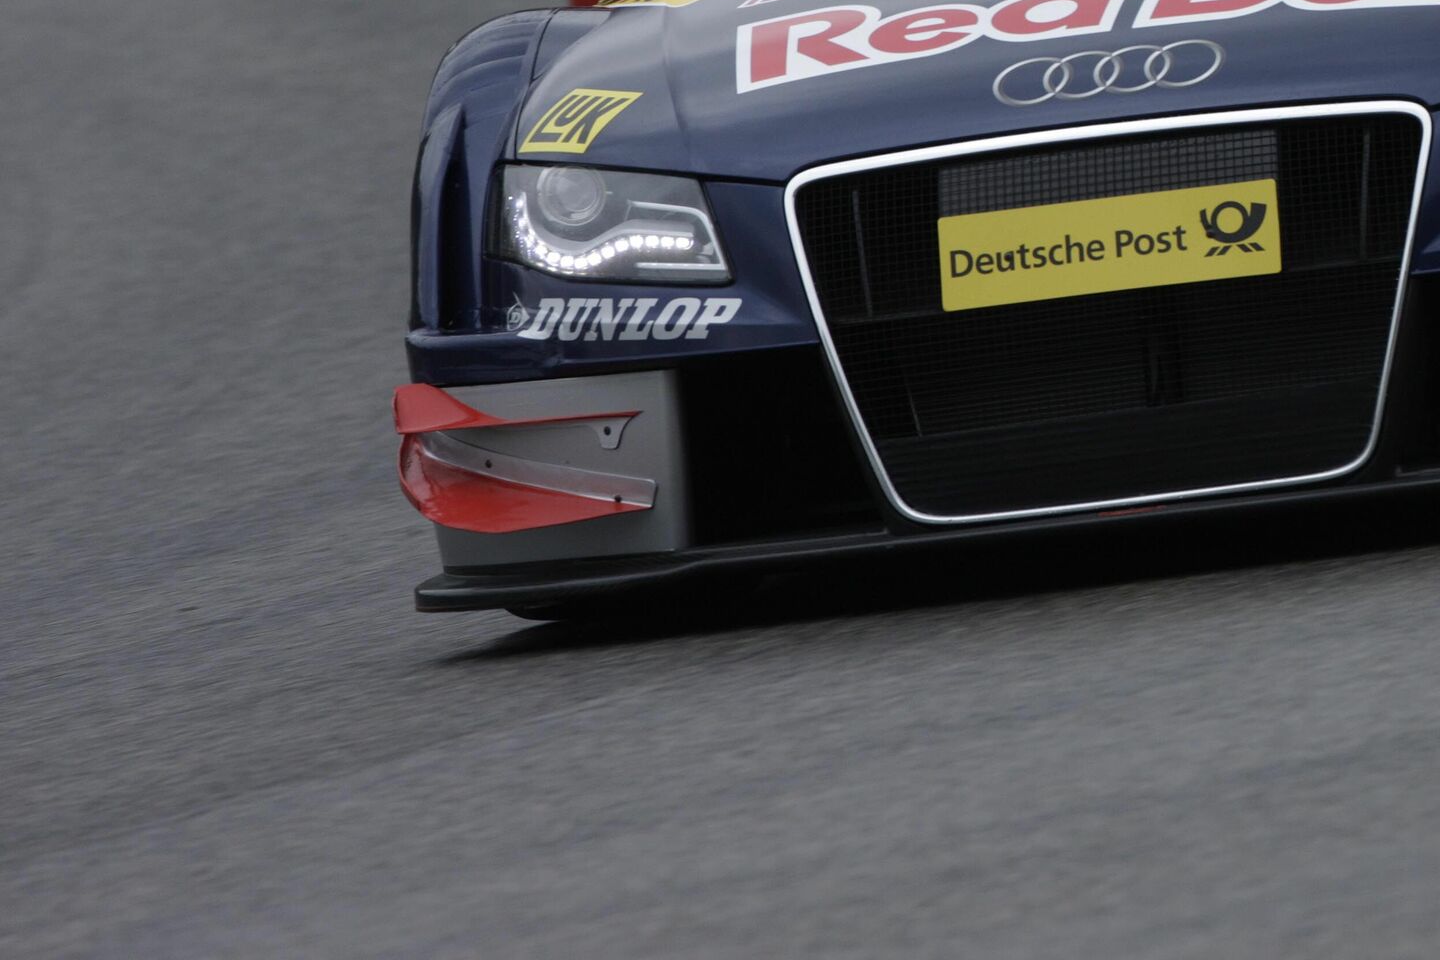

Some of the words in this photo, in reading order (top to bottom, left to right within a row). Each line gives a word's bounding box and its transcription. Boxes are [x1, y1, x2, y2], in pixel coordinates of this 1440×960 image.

[950, 235, 1105, 278] Deutsche
[1115, 226, 1188, 258] Post
[517, 297, 743, 341] DUNLOP
